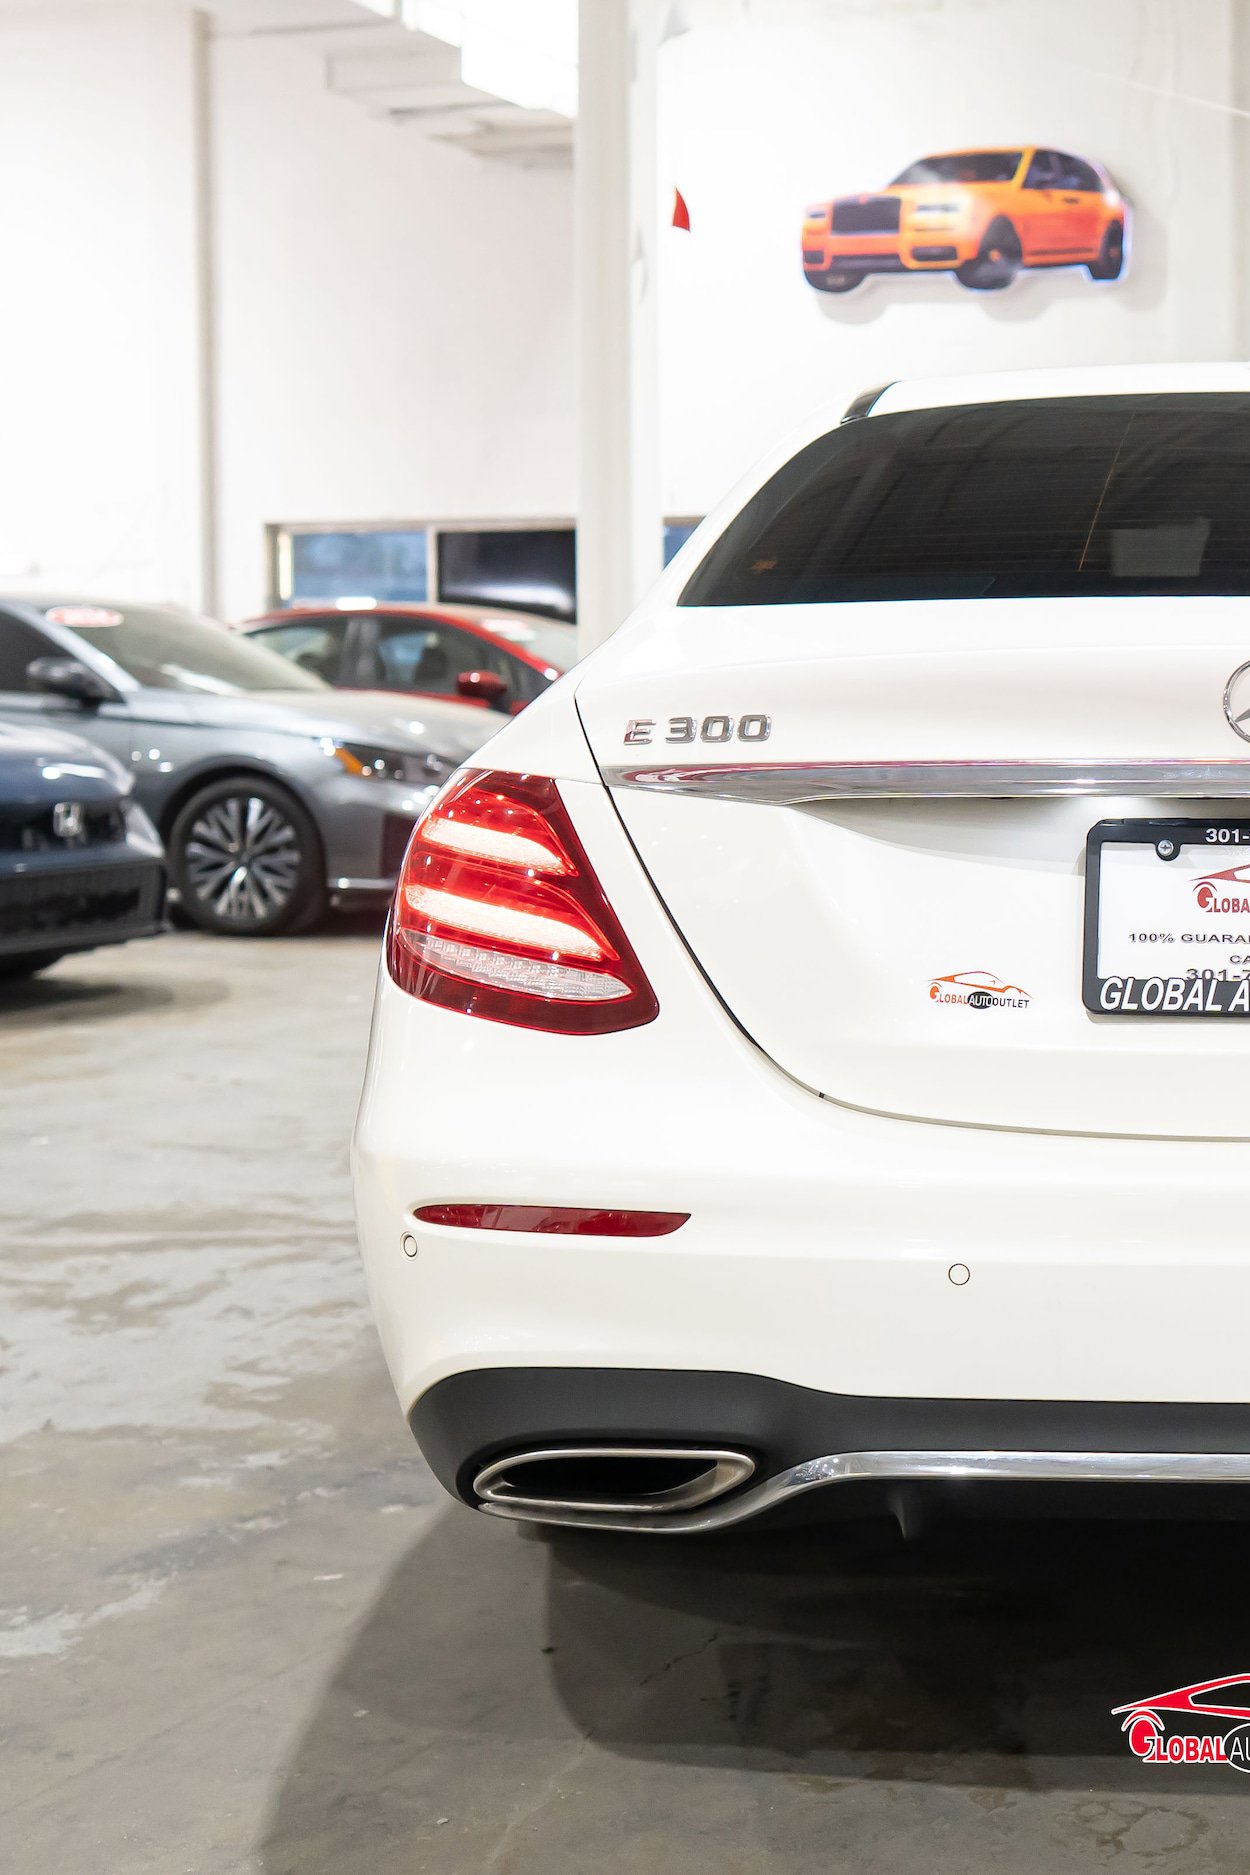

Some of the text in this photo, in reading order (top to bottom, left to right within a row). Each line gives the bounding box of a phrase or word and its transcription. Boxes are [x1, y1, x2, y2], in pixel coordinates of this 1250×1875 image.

[623, 715, 772, 745] E 300
[1129, 933, 1174, 943] 100%
[1098, 976, 1222, 1012] GLOBAL
